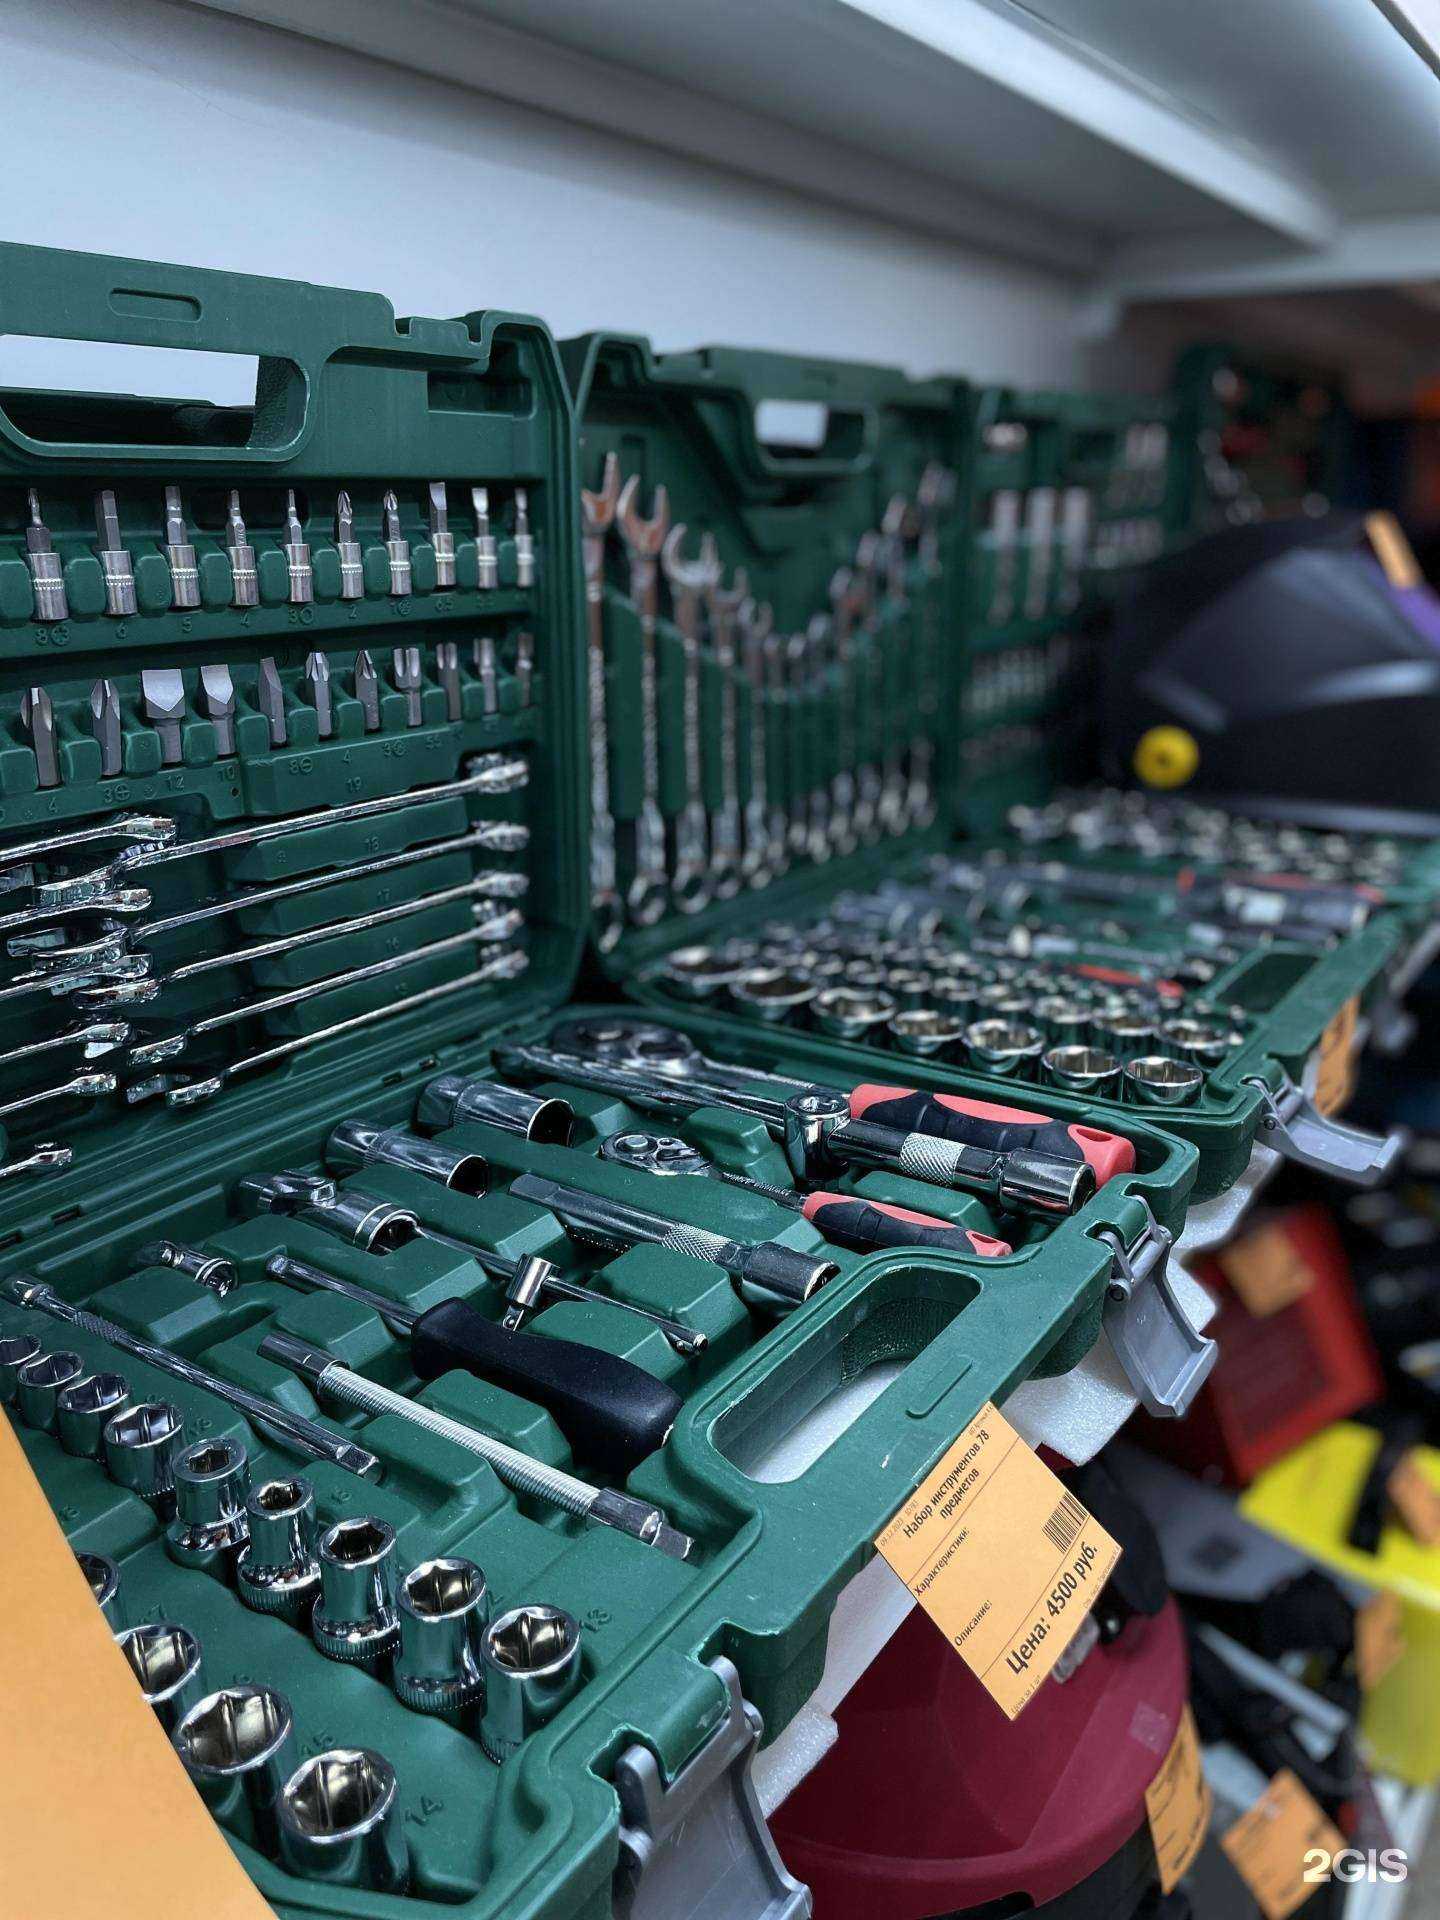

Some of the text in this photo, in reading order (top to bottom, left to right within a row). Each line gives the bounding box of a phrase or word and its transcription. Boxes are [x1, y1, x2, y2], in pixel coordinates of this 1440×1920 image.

[903, 1505, 933, 1538] Набор
[930, 1442, 981, 1506] инструментов
[976, 1429, 990, 1445] 78
[940, 1468, 980, 1519] предметов
[914, 1526, 971, 1596] Характеристики:
[954, 1600, 993, 1647] Описание:
[1005, 1541, 1098, 1675] Цена: 4500 руб.
[404, 1797, 445, 1826] 14
